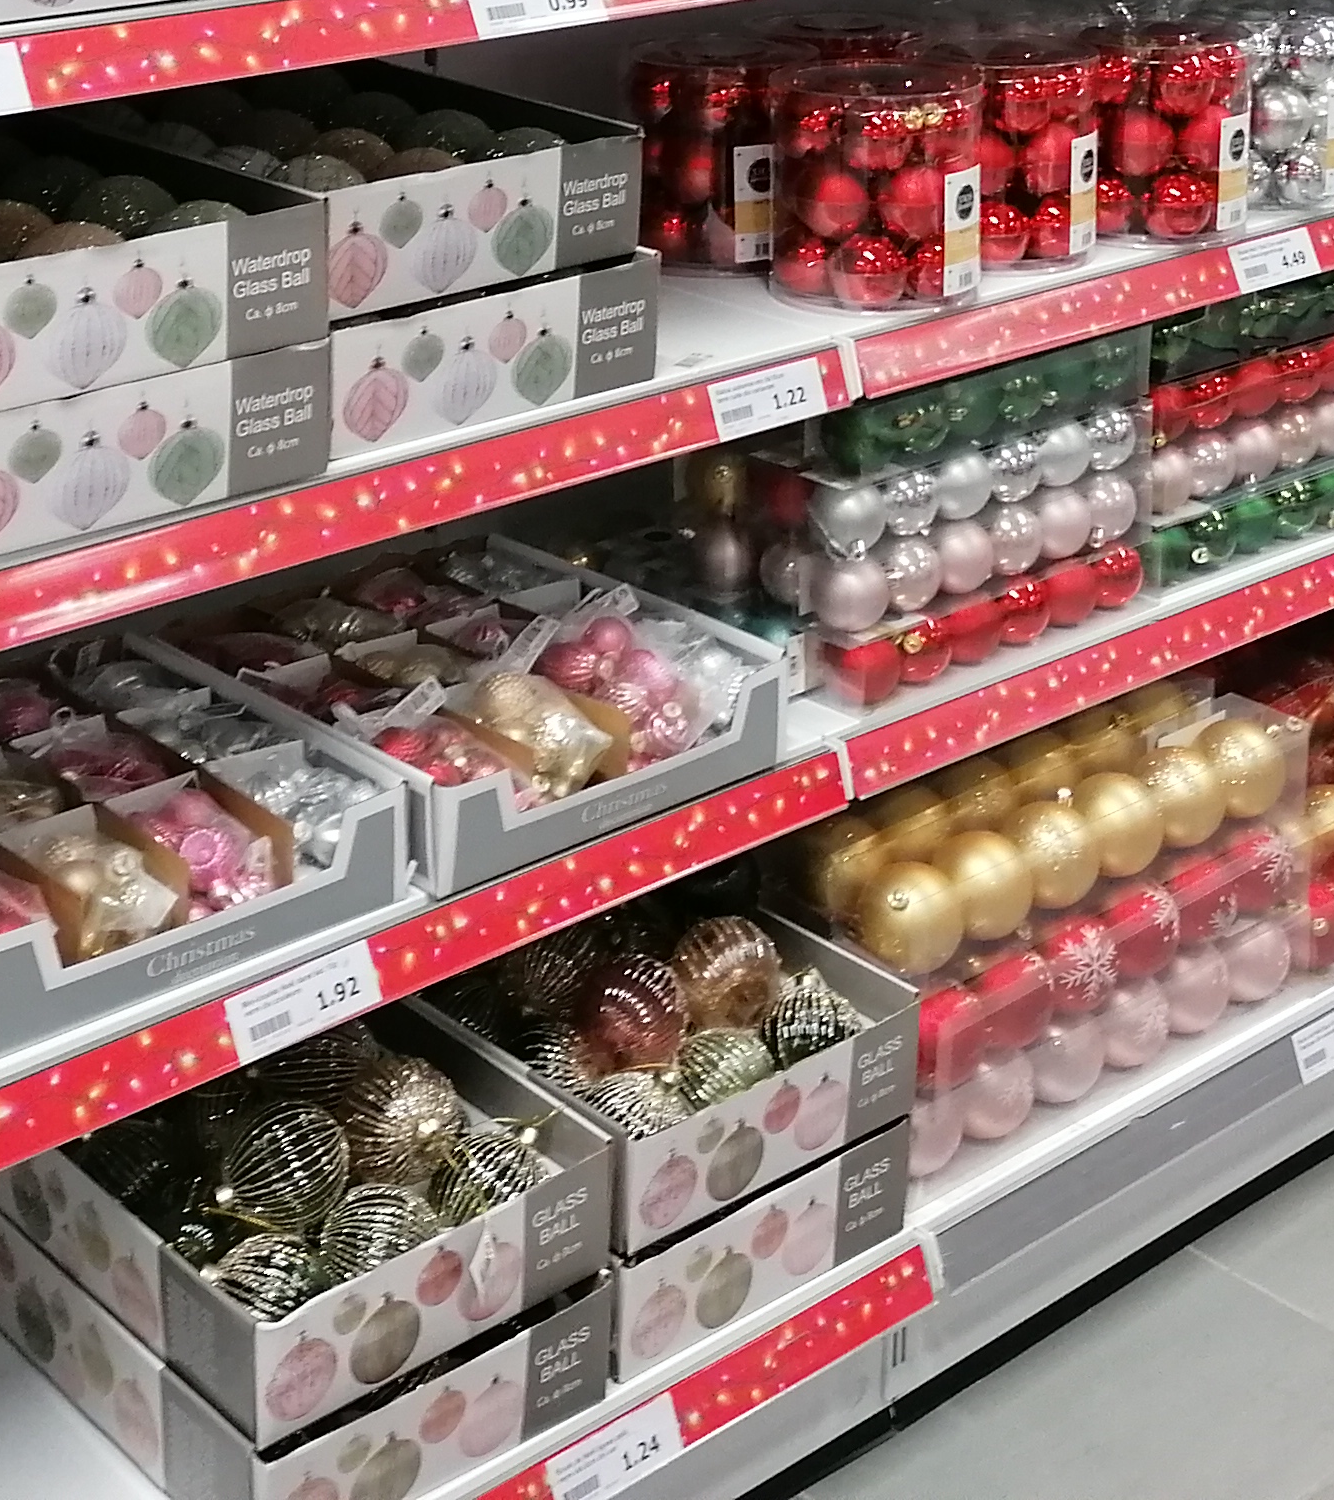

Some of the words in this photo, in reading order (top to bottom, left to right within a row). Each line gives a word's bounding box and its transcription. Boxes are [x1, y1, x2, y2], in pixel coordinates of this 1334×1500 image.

[563, 172, 629, 197] Waterdrop
[563, 198, 600, 217] Glass
[602, 189, 626, 209] Ball
[231, 248, 312, 277] Waterdrop
[1281, 251, 1306, 268] 4.49
[233, 278, 279, 299] Glass
[281, 267, 311, 289] Ball
[581, 299, 646, 325] Waterdrop
[581, 326, 618, 345] Glass
[620, 316, 644, 336] Ball
[235, 385, 314, 416] Waterdrop
[773, 387, 806, 409] 1.22
[235, 415, 281, 438] Glass
[283, 403, 313, 426] Ball
[146, 926, 256, 978] Christmas
[316, 976, 361, 1011] 1.92
[857, 1035, 903, 1069] GLASS
[861, 1058, 894, 1086] BALL
[843, 1157, 892, 1192] GLASS
[532, 1186, 588, 1228] GLASS
[848, 1181, 884, 1209] BALL
[539, 1214, 580, 1246] BALL
[534, 1325, 591, 1366] GLASS
[540, 1351, 582, 1384] BALL
[623, 1434, 661, 1471] 1.24
